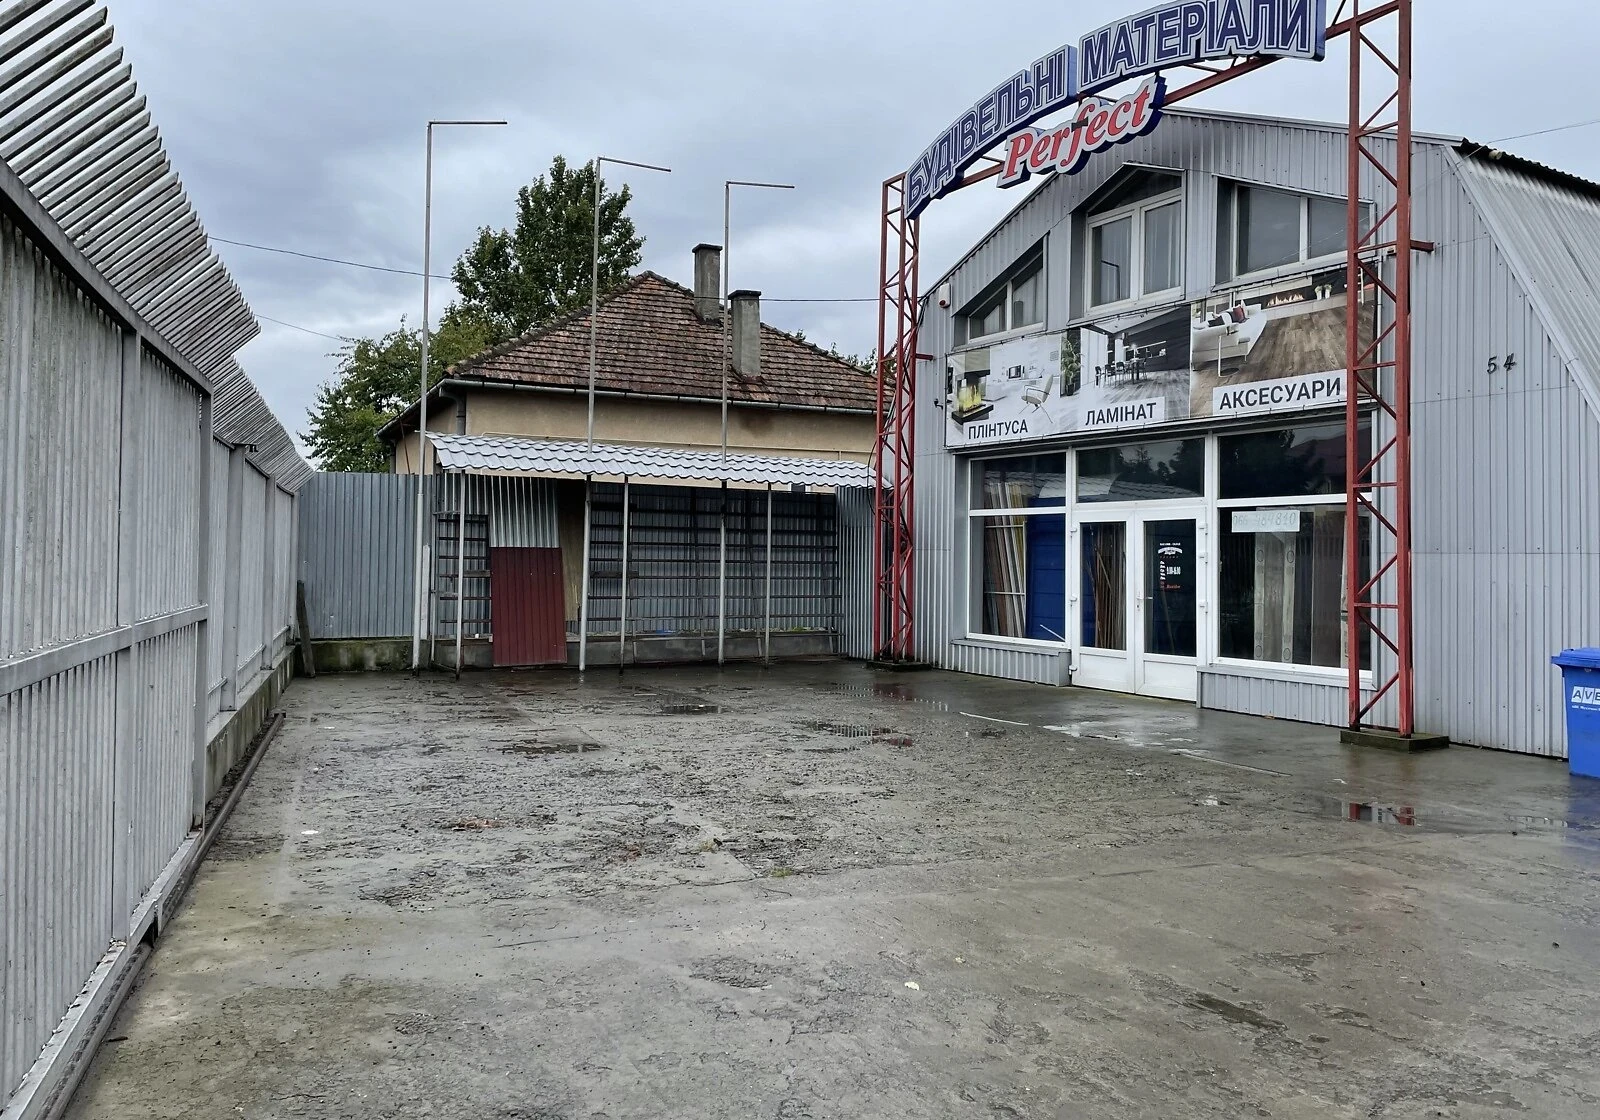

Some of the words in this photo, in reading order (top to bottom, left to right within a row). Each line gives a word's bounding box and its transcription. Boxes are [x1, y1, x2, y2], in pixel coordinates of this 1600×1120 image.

[906, 48, 1067, 211] БУДІВЕЛЬНІ
[1080, 0, 1311, 87] МАТЕРІАЛИ
[1002, 84, 1151, 180] Perfect
[1219, 377, 1341, 411] АКСЕСУАРИ
[968, 419, 1029, 440] ПЛІНТУСА
[1085, 402, 1157, 426] ЛАМІНАТ
